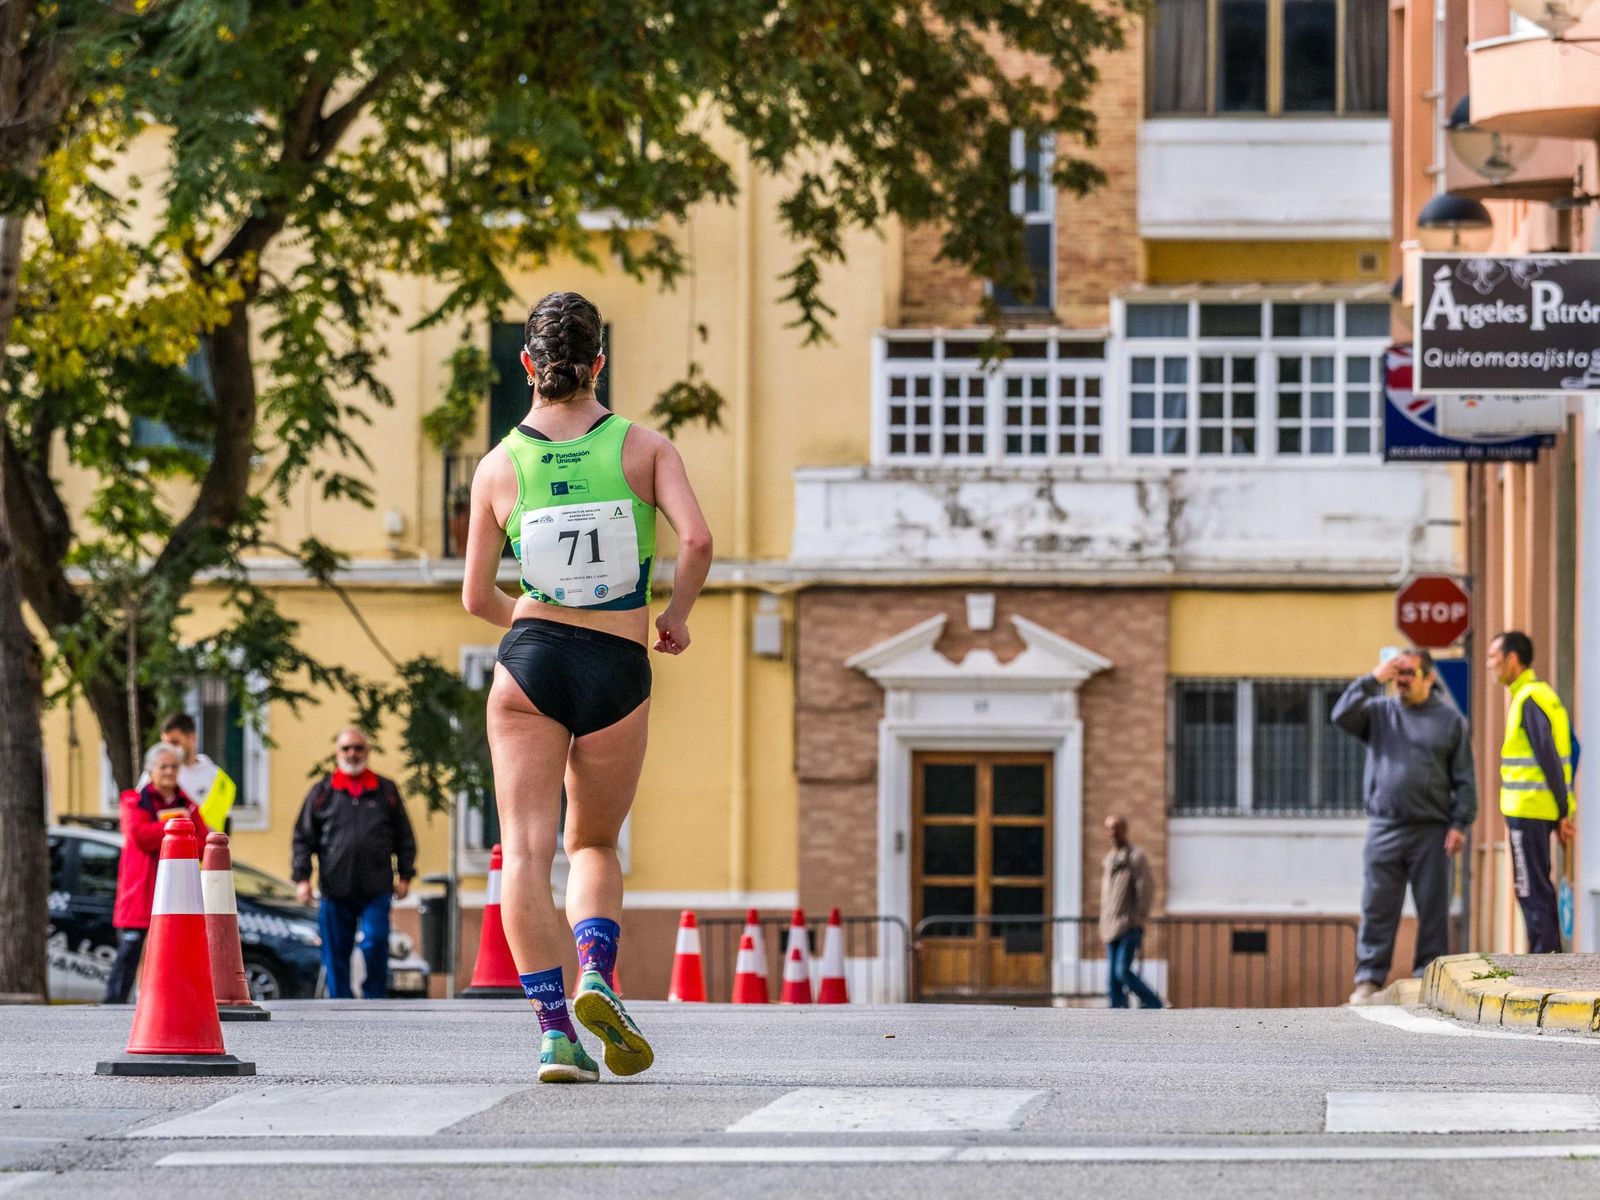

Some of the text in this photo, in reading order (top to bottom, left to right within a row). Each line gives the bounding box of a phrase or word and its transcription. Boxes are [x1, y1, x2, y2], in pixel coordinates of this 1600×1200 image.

[1423, 264, 1527, 331] Ángeles
[1423, 347, 1590, 372] Quiromasajista
[555, 450, 590, 459] Fundación
[558, 527, 605, 566] 71
[1401, 602, 1466, 623] STOP
